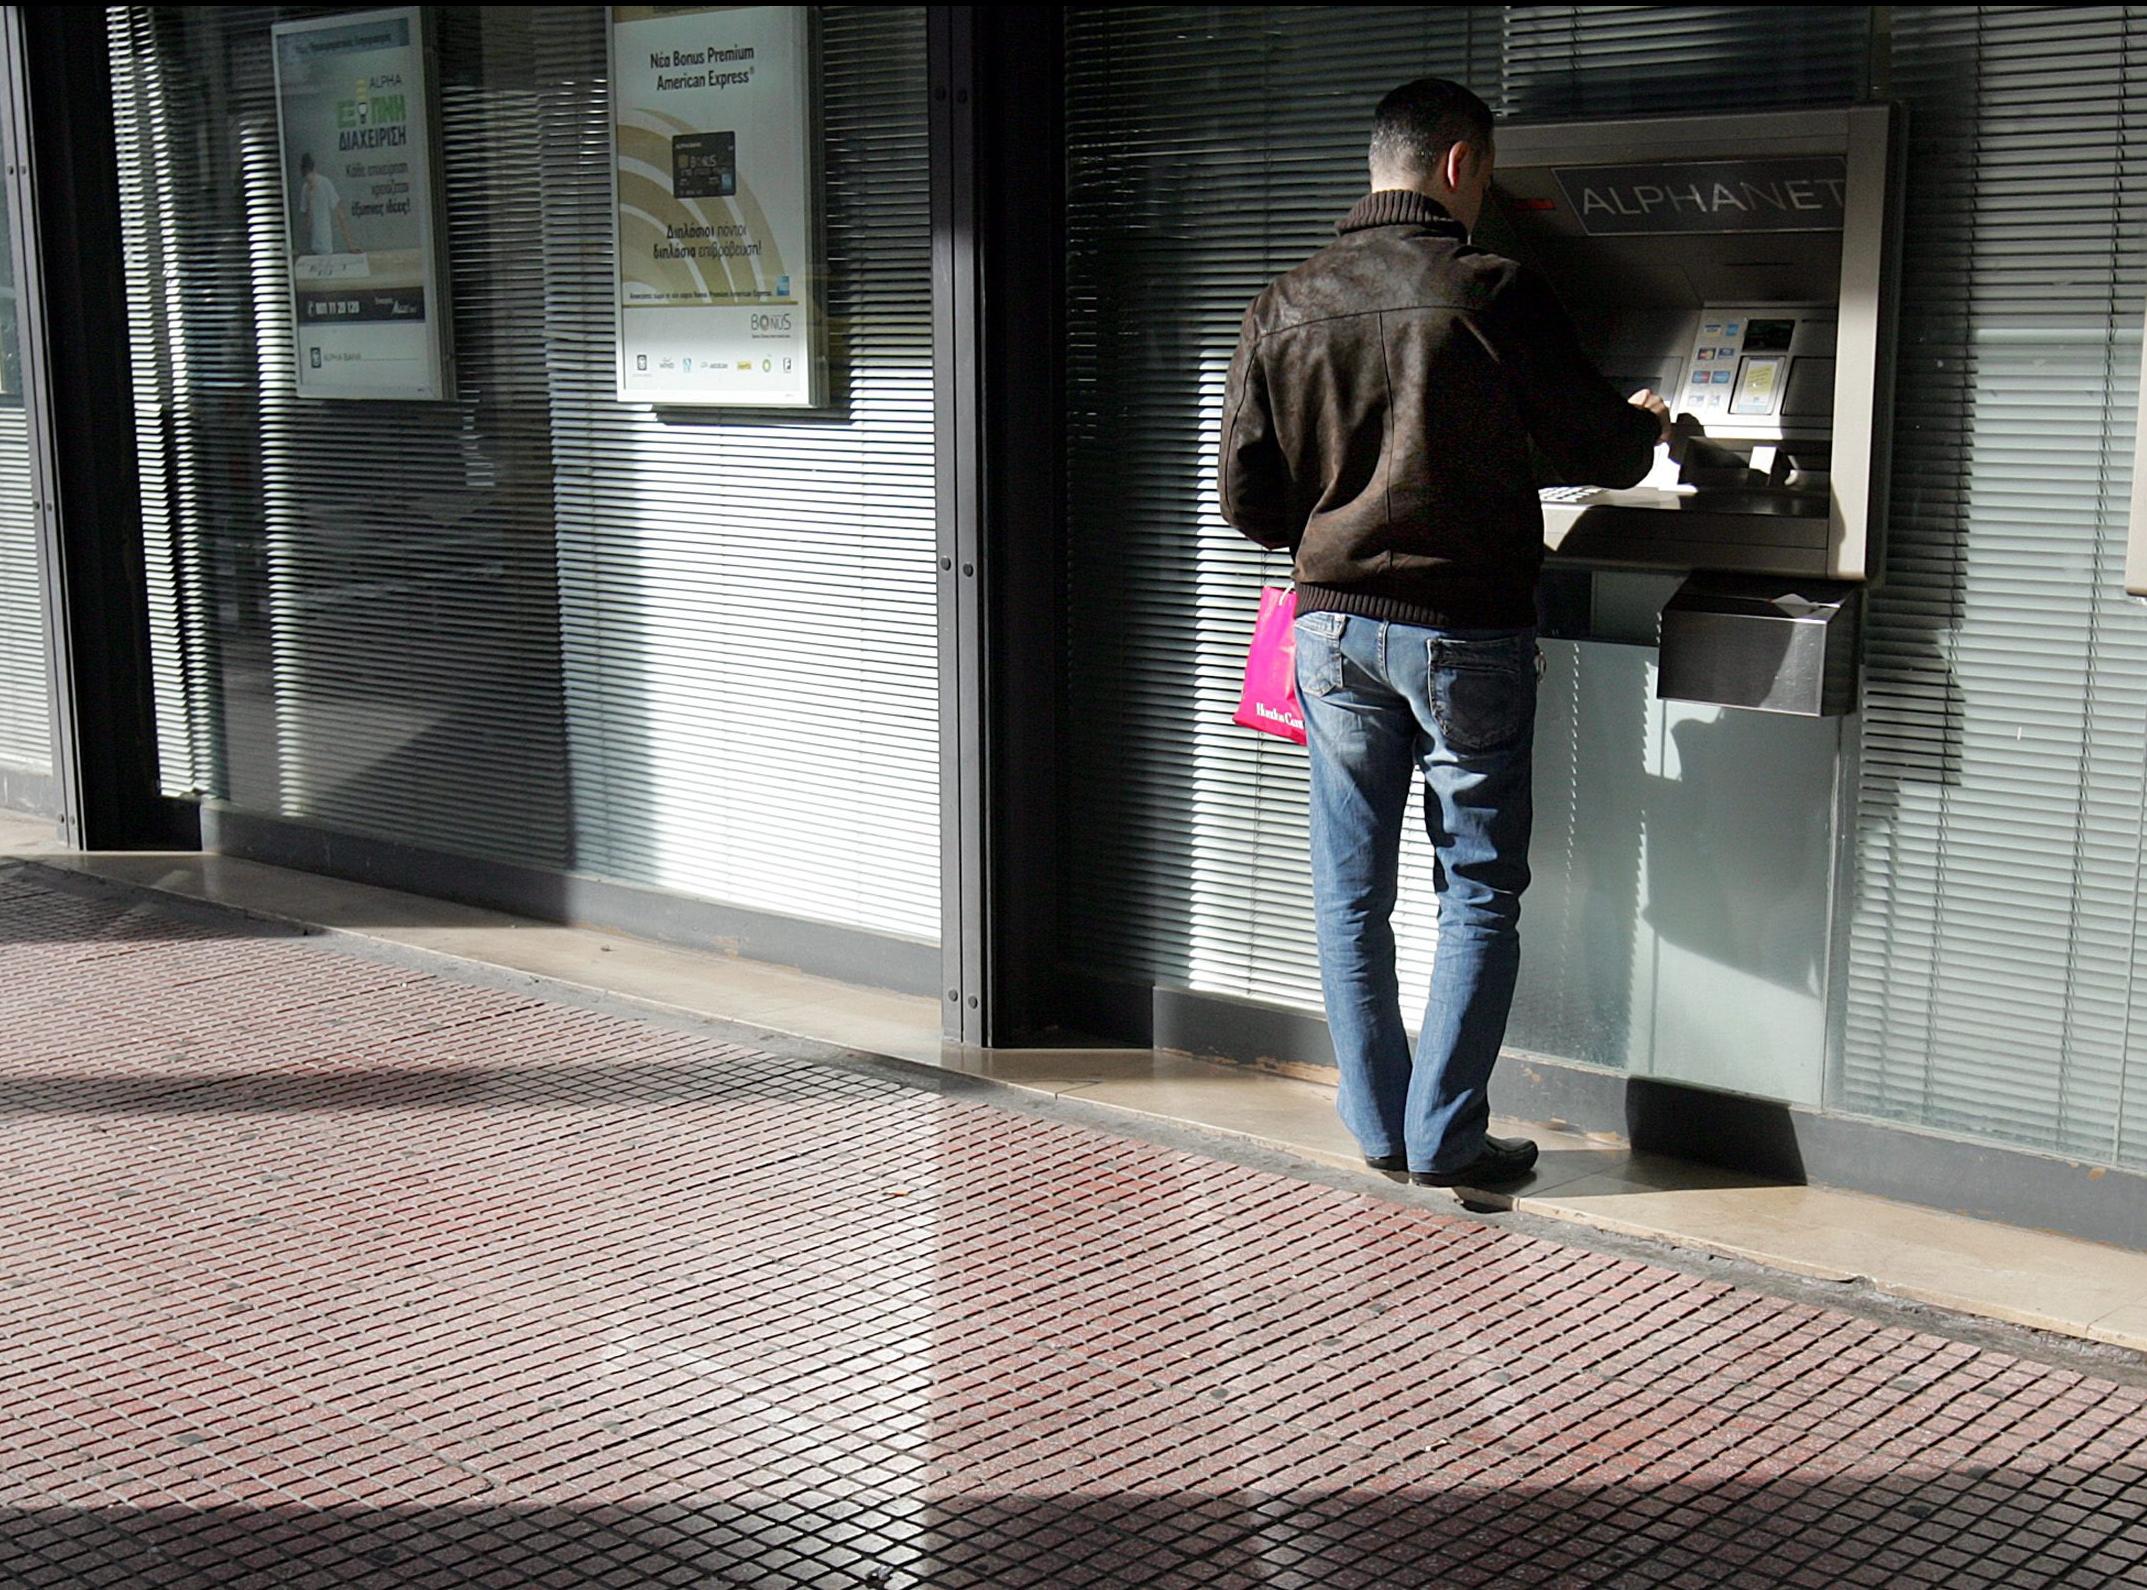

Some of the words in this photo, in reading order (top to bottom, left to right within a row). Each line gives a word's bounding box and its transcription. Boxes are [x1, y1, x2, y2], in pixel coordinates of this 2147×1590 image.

[673, 50, 705, 66] Bonus
[707, 44, 754, 64] Premium
[369, 74, 402, 89] ALPHA
[656, 72, 706, 91] American
[339, 126, 407, 151] ΔΙΑΧΕΙΡΙΣΗ
[1584, 179, 1845, 216] ALPHANET
[751, 313, 792, 331] BONUS
